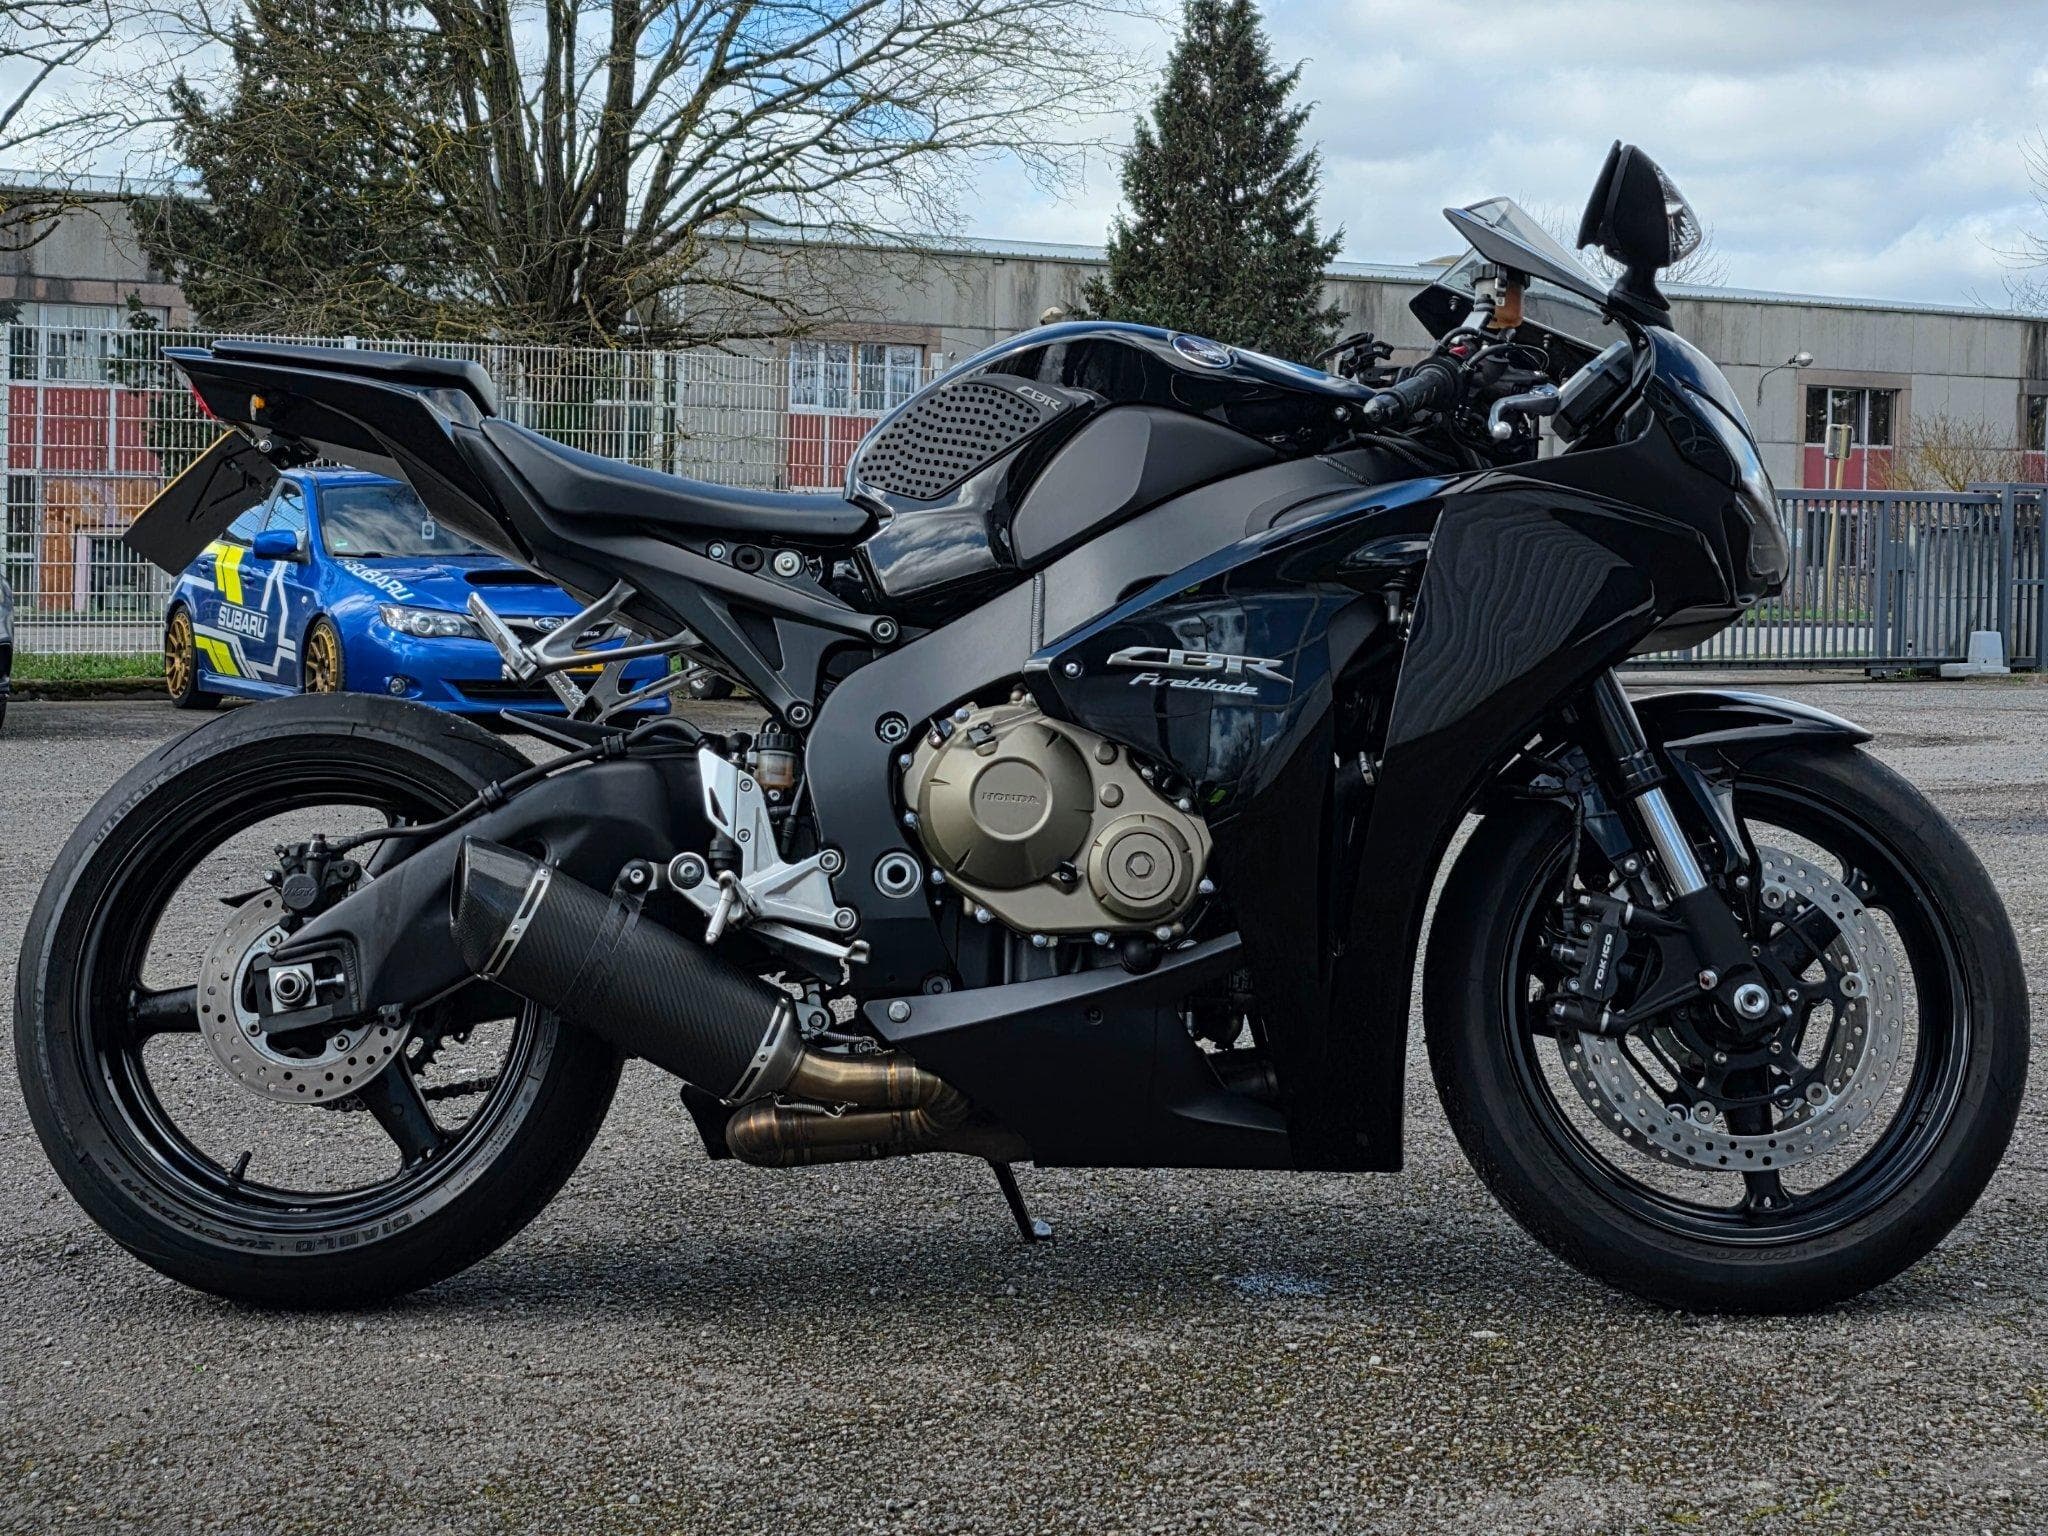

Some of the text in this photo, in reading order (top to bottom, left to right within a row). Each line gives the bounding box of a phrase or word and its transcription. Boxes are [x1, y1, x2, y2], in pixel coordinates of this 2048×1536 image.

[1016, 385, 1062, 411] CBR
[344, 560, 416, 601] SUBARU
[217, 604, 268, 638] SUBARU
[1106, 645, 1295, 686] CBR
[1129, 672, 1259, 696] Fireblade
[981, 791, 1040, 805] HONDA
[1594, 933, 1613, 990] TOKICO
